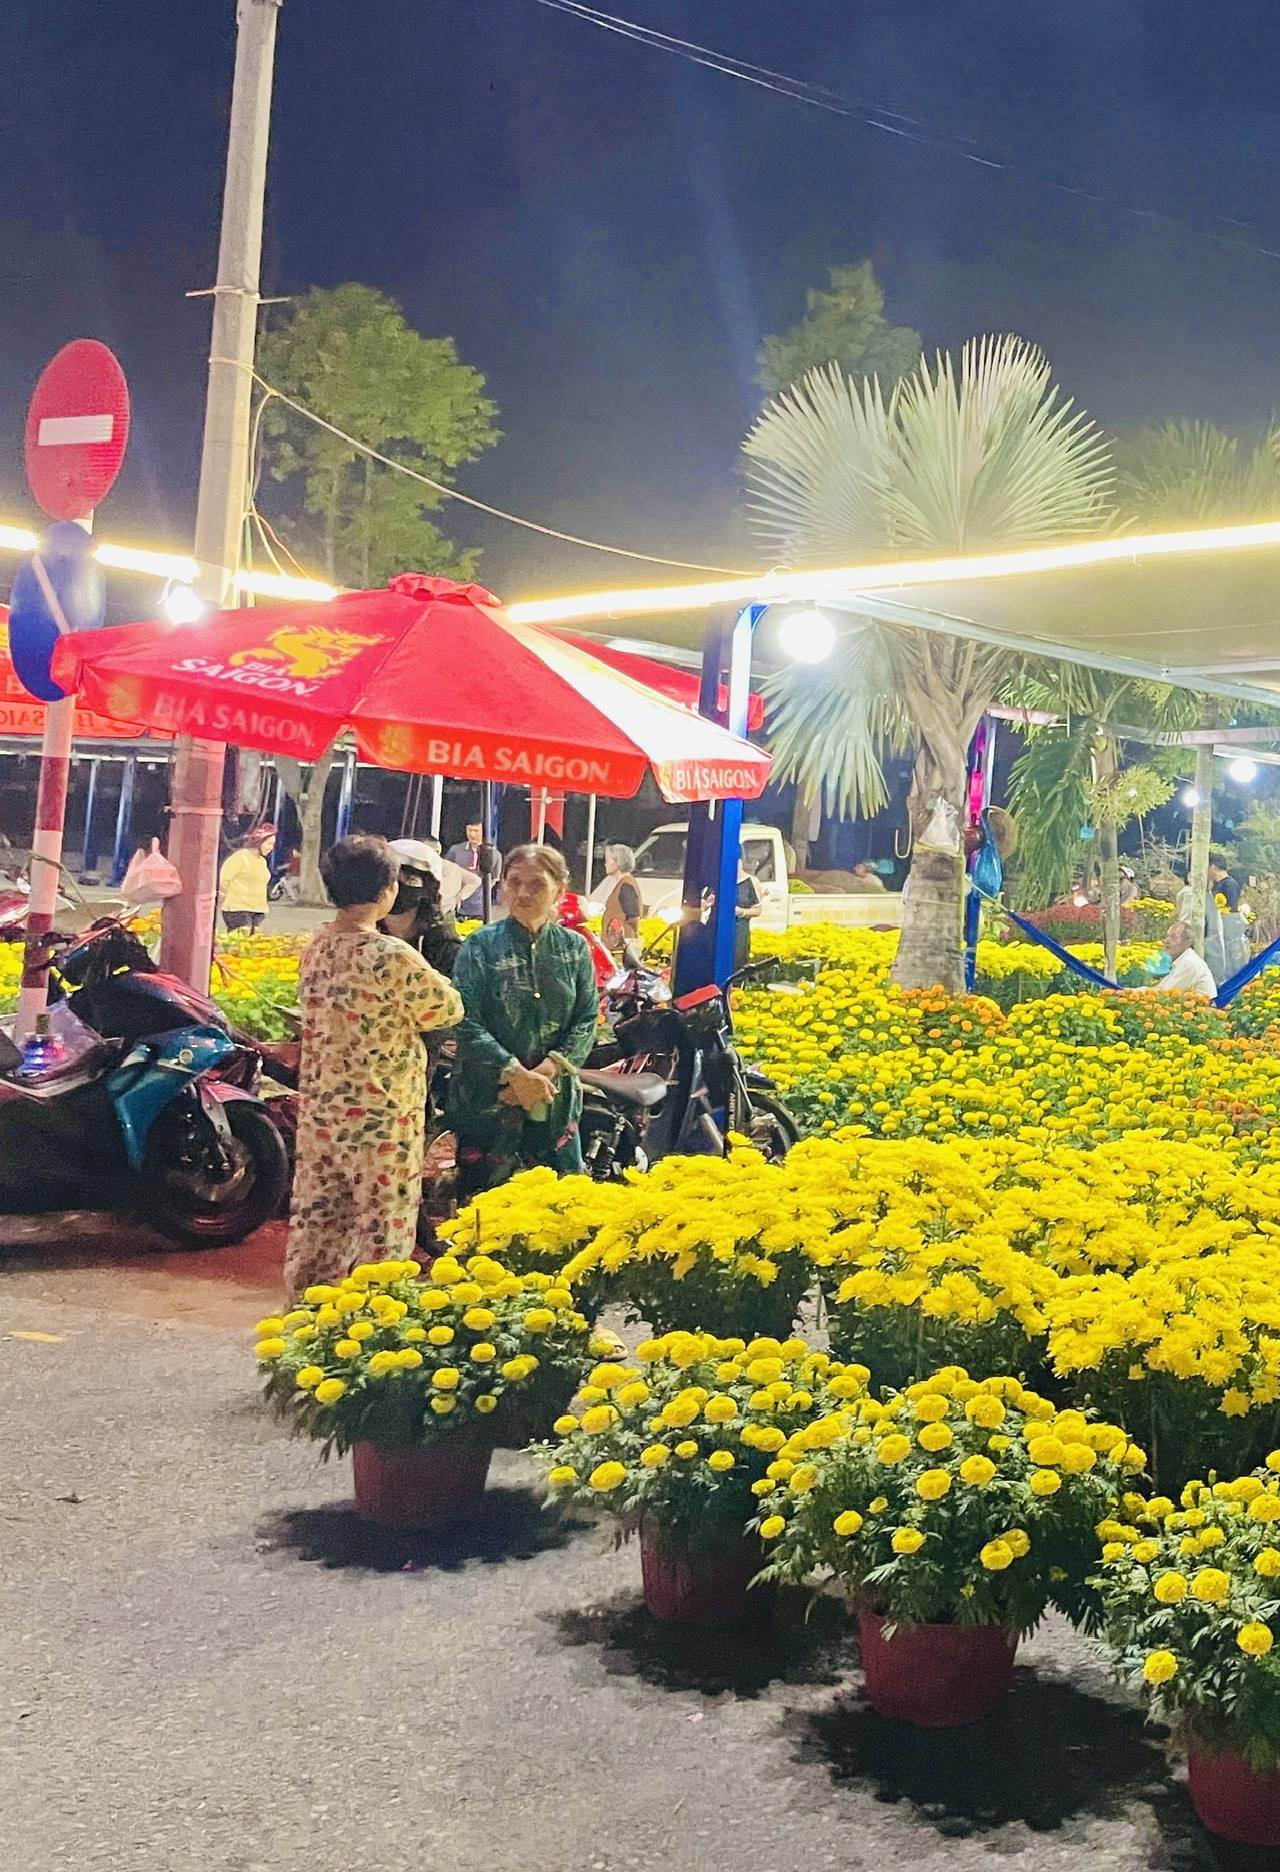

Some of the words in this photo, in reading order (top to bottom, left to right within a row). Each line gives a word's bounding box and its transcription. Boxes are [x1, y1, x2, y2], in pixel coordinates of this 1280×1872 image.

[171, 658, 320, 697] SAIGON
[242, 662, 287, 676] BIA
[152, 693, 206, 727] BIA
[212, 704, 315, 748] SAIGON
[427, 739, 486, 770] BIA
[494, 746, 610, 783] SAIGON
[675, 768, 701, 791] BIA
[701, 767, 759, 790] SAIGON
